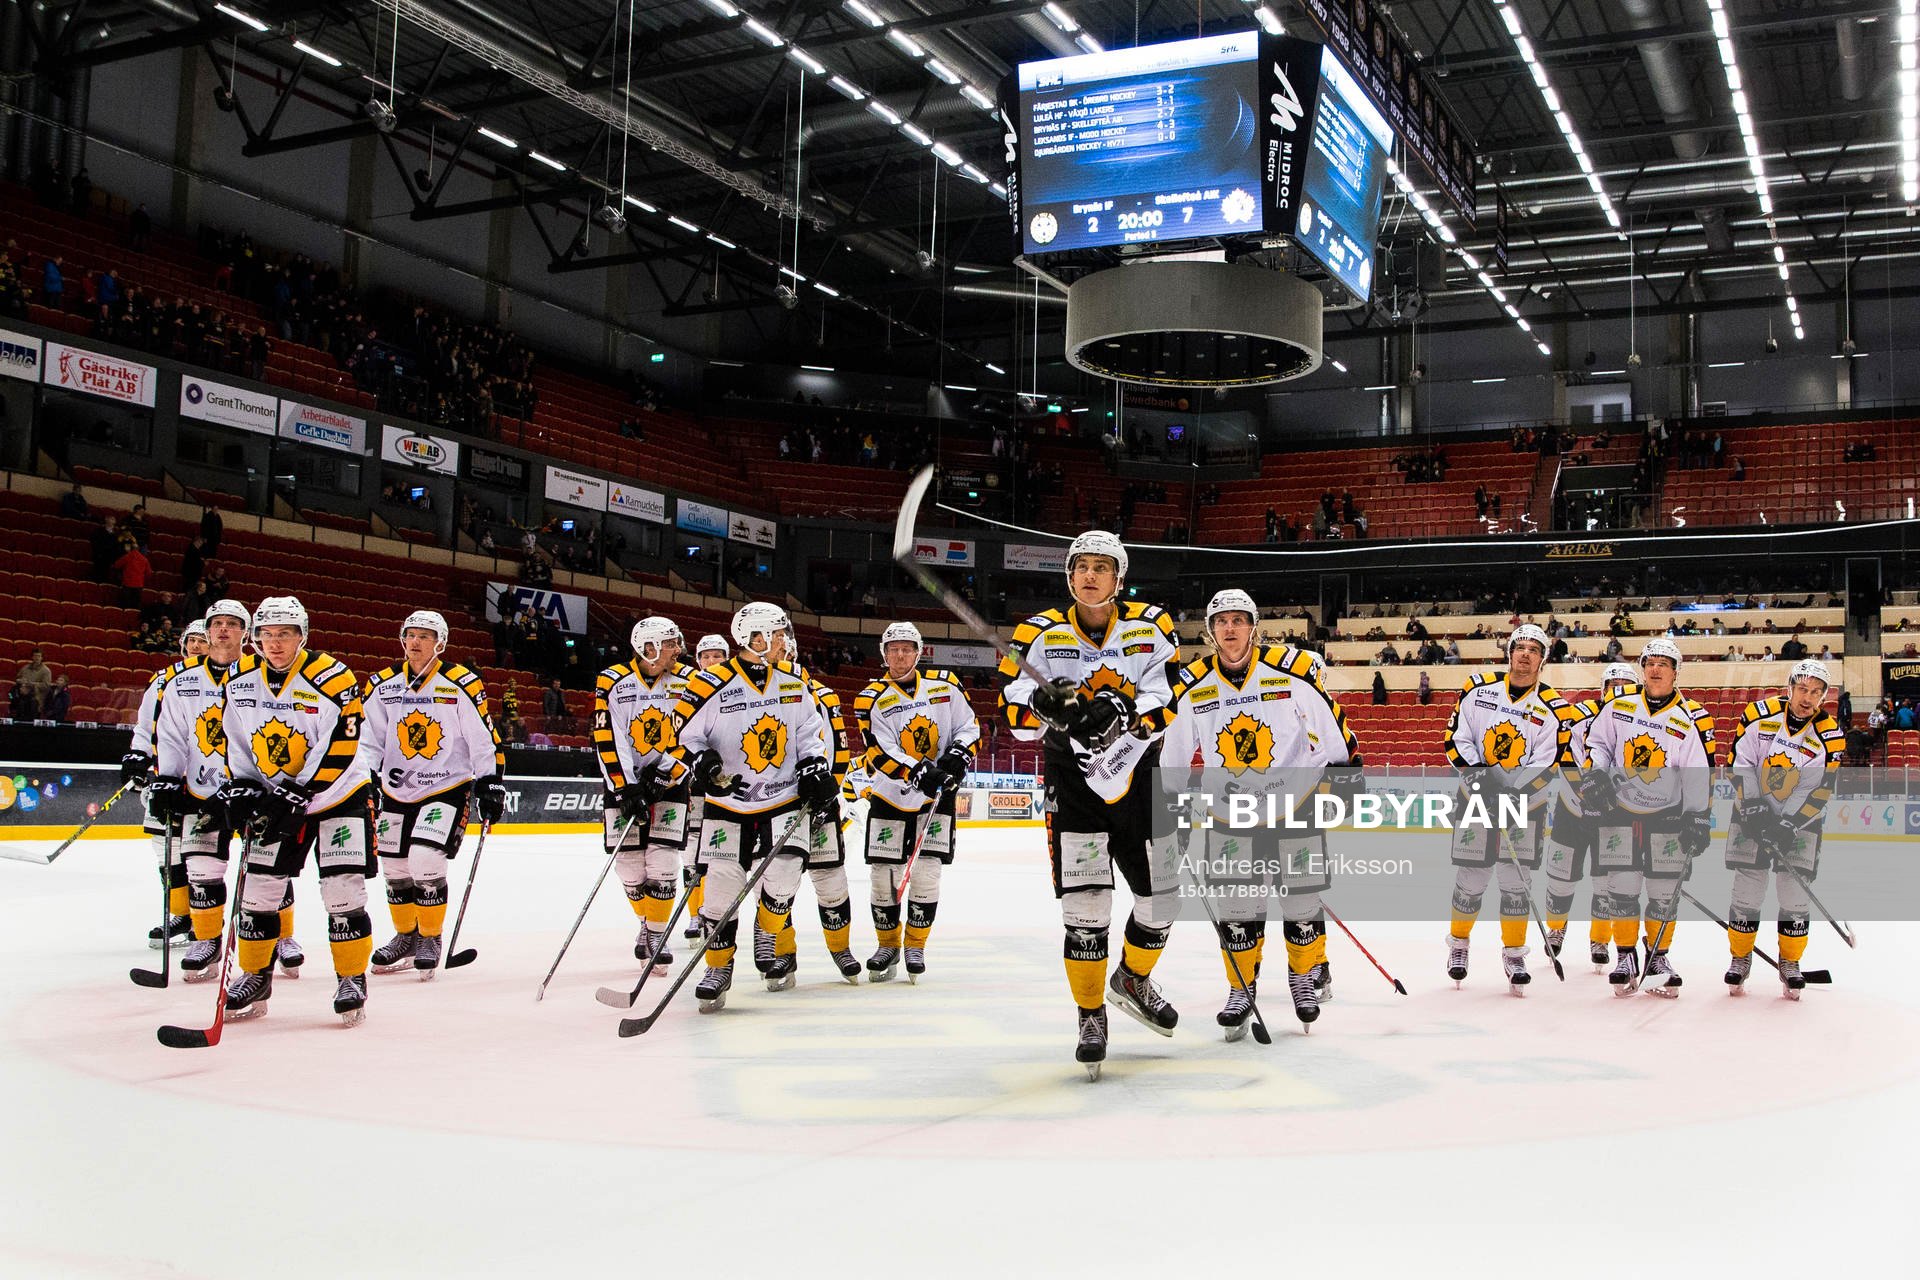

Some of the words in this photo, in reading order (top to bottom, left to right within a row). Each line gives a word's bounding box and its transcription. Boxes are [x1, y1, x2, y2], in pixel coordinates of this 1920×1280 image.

[1331, 21, 1350, 52] 1968
[1353, 49, 1369, 78] 1970
[1110, 91, 1137, 101] HOCKEY
[1372, 76, 1386, 101] 1971
[1390, 100, 1404, 127] 1972
[1101, 127, 1128, 137] HOCKEY
[1406, 123, 1420, 148] 1976
[1267, 140, 1279, 182] Electro
[1423, 144, 1435, 166] 1977
[1280, 142, 1292, 209] MIDROC
[1088, 217, 1098, 232] 2
[1118, 210, 1163, 229] 20:00
[1182, 207, 1193, 223] 7
[79, 357, 139, 382] Gästrike
[81, 371, 111, 389] Plåt
[115, 381, 137, 394] AB
[206, 392, 234, 409] Grant
[234, 398, 276, 418] Thornton
[299, 426, 320, 438] Gefle
[320, 429, 351, 445] Dagblad
[403, 439, 440, 458] WEWAB
[625, 495, 664, 514] Ramudden
[1548, 543, 1612, 555] ARENA
[1121, 628, 1153, 640] engcon
[1261, 678, 1289, 687] engcon
[727, 688, 743, 697] LEAB
[1225, 695, 1259, 706] BOLIDEN
[1484, 689, 1499, 697] LEAB
[235, 699, 256, 707] KODA
[750, 698, 779, 708] BOLIDEN
[345, 716, 357, 737] 3
[595, 711, 607, 728] 14
[1637, 719, 1663, 730] BOLIDEN
[388, 768, 418, 788] SK
[992, 796, 1026, 807] GROLLS
[924, 838, 949, 847] artinsons
[1785, 854, 1813, 864] artinsons
[1070, 949, 1106, 960] NORRAN
